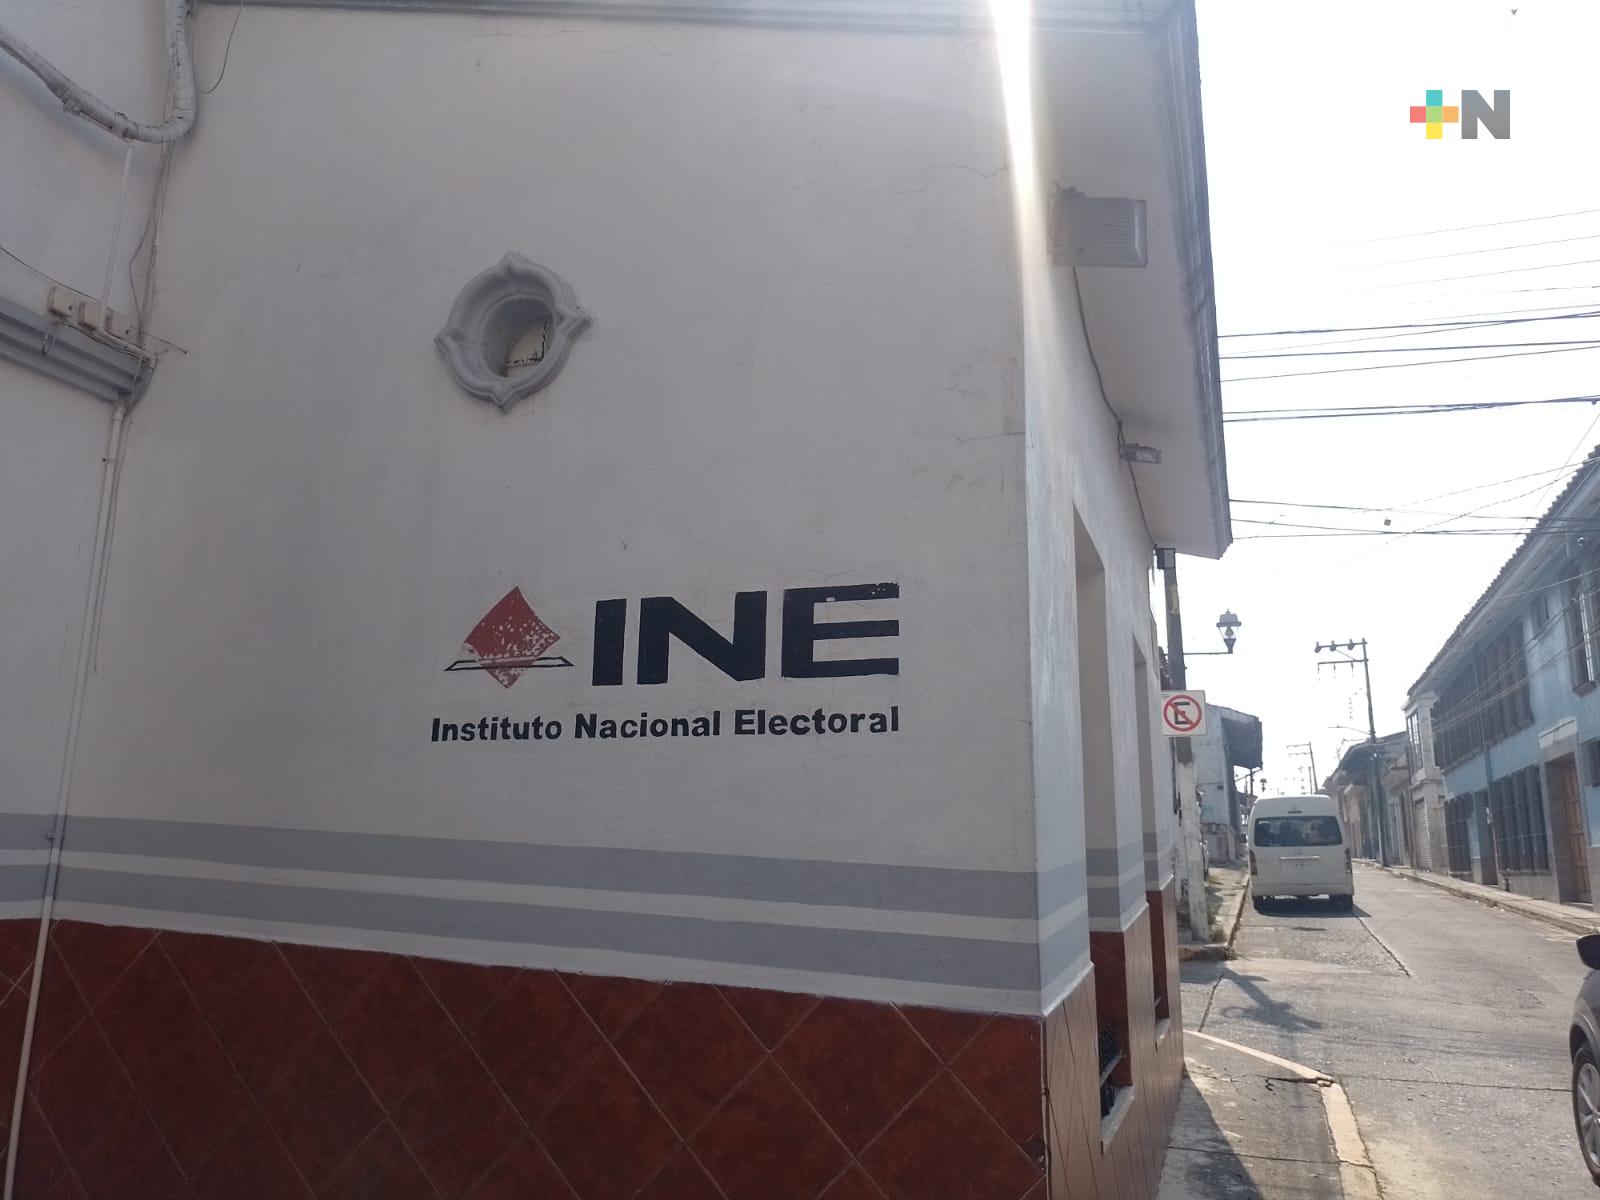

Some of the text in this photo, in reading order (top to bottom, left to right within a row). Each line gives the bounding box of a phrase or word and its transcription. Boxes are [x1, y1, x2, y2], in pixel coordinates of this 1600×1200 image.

[592, 583, 900, 686] INE
[430, 706, 900, 742] Instituto Nacional Electoral
[1173, 701, 1191, 725] E
